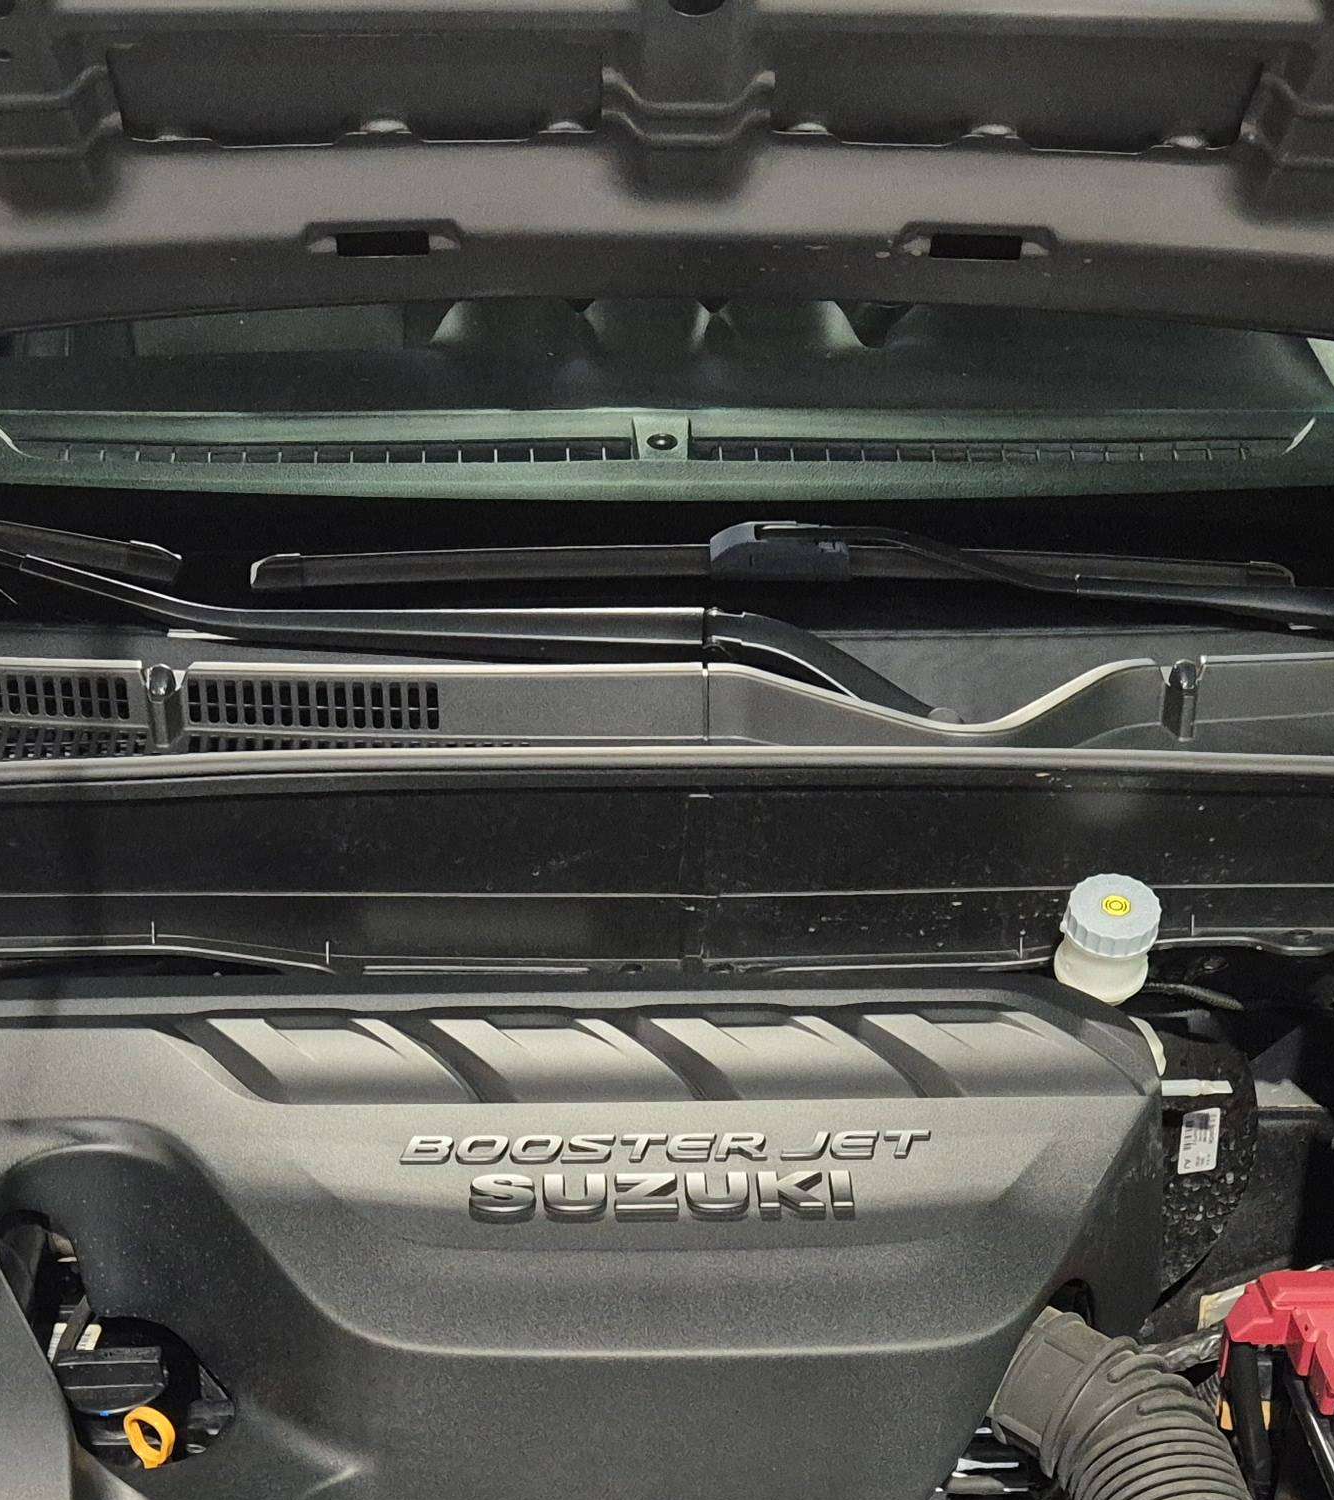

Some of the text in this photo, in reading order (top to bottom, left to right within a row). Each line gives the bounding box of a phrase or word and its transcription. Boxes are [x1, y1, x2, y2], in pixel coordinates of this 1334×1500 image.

[399, 1130, 933, 1165] BOOSTER JET
[468, 1168, 856, 1219] SUZUKI
